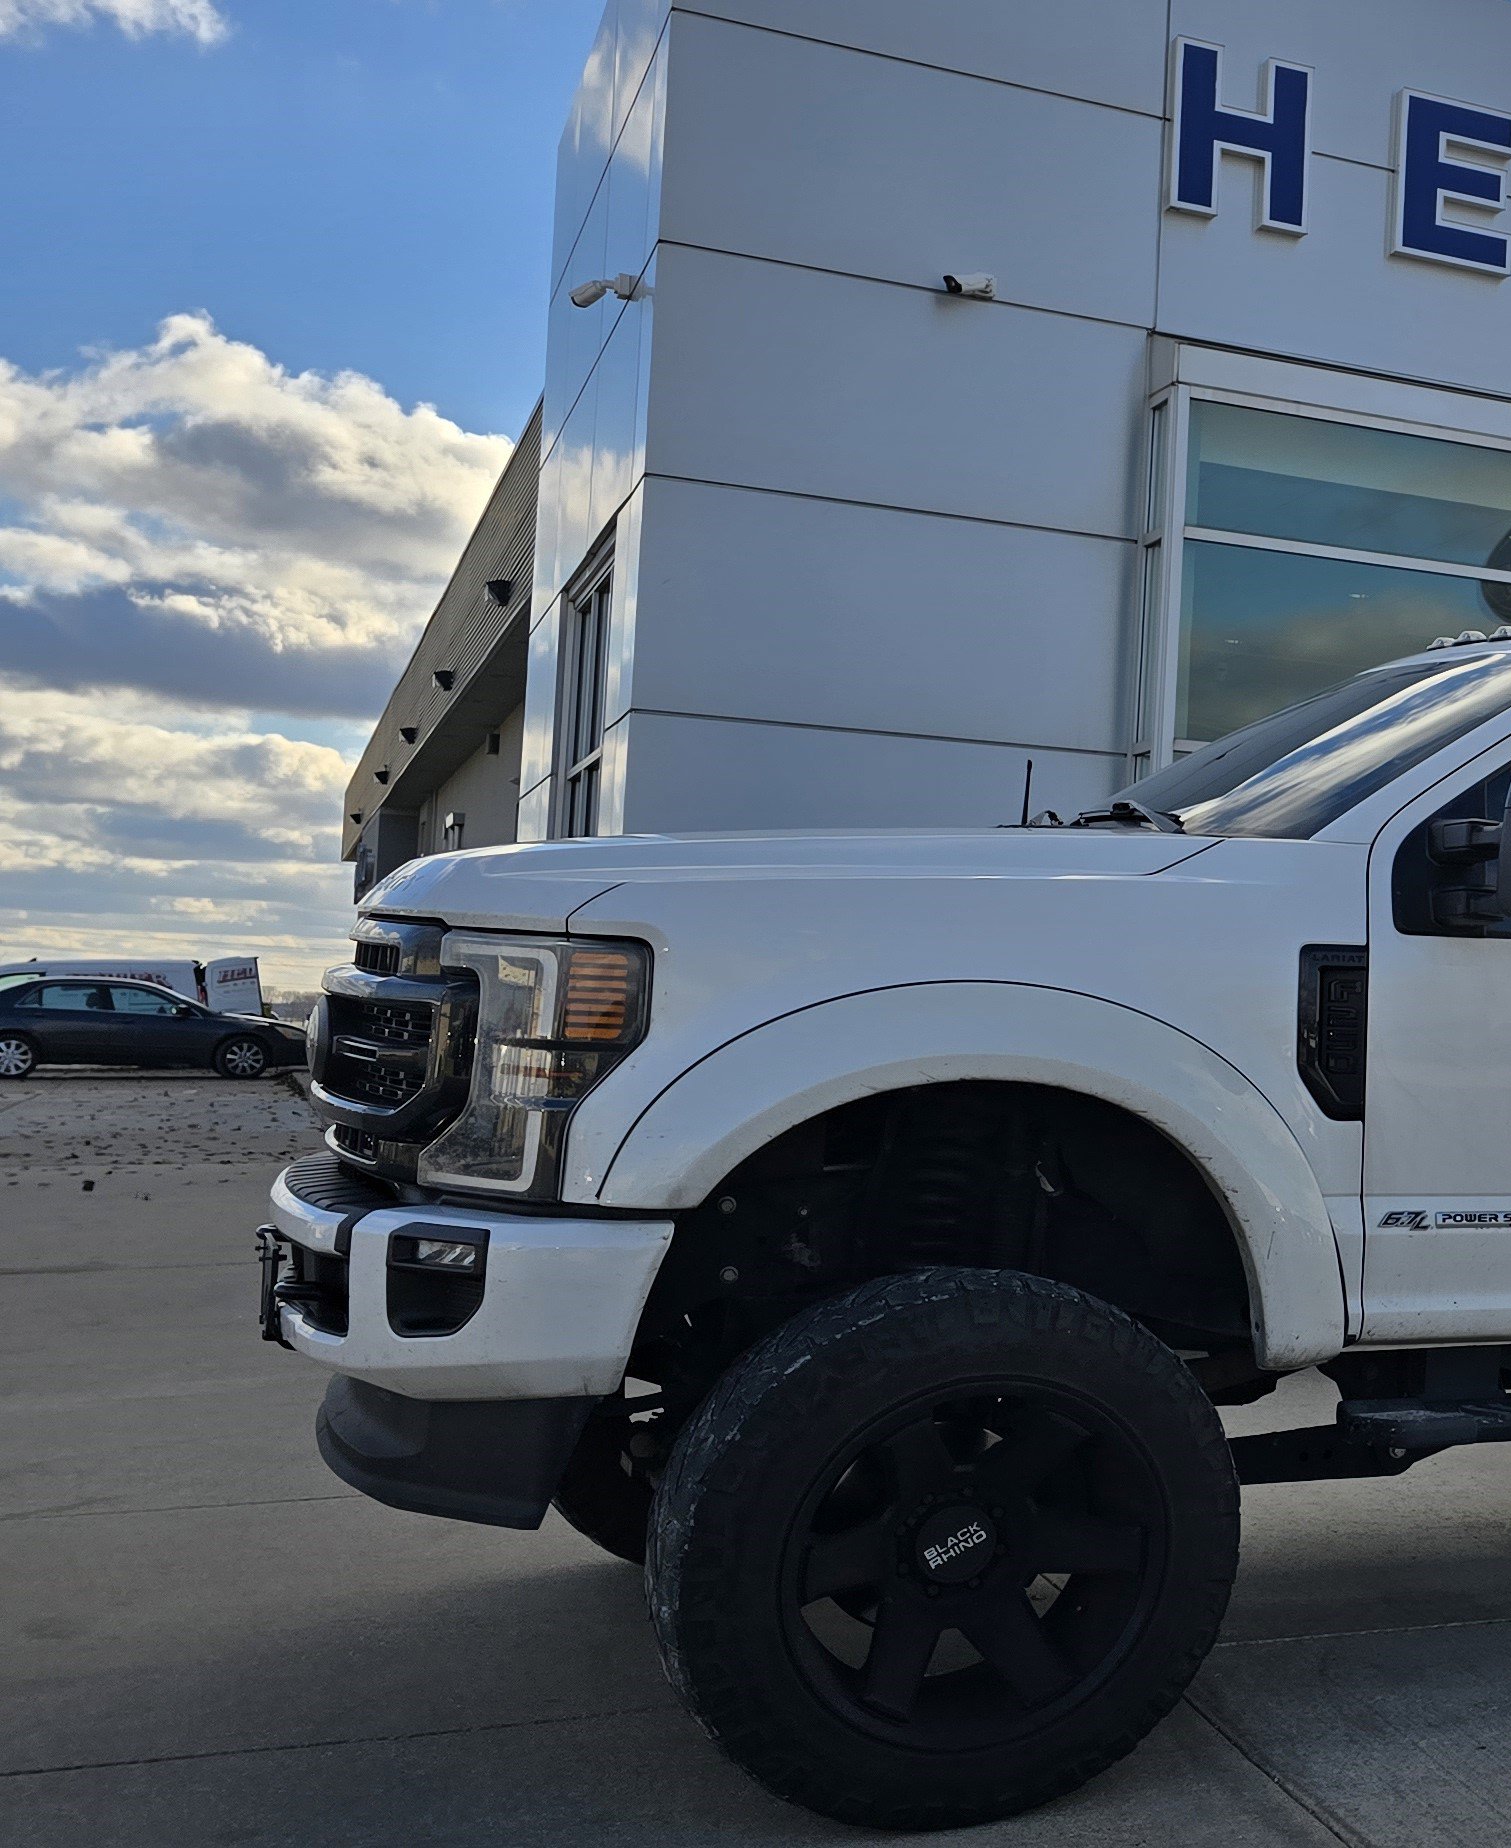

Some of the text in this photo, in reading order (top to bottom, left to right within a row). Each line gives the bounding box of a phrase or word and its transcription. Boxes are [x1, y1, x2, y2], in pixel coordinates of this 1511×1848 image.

[1441, 1213, 1499, 1223] POWER
[923, 1521, 982, 1560] BLACK
[928, 1530, 987, 1570] RHINO
